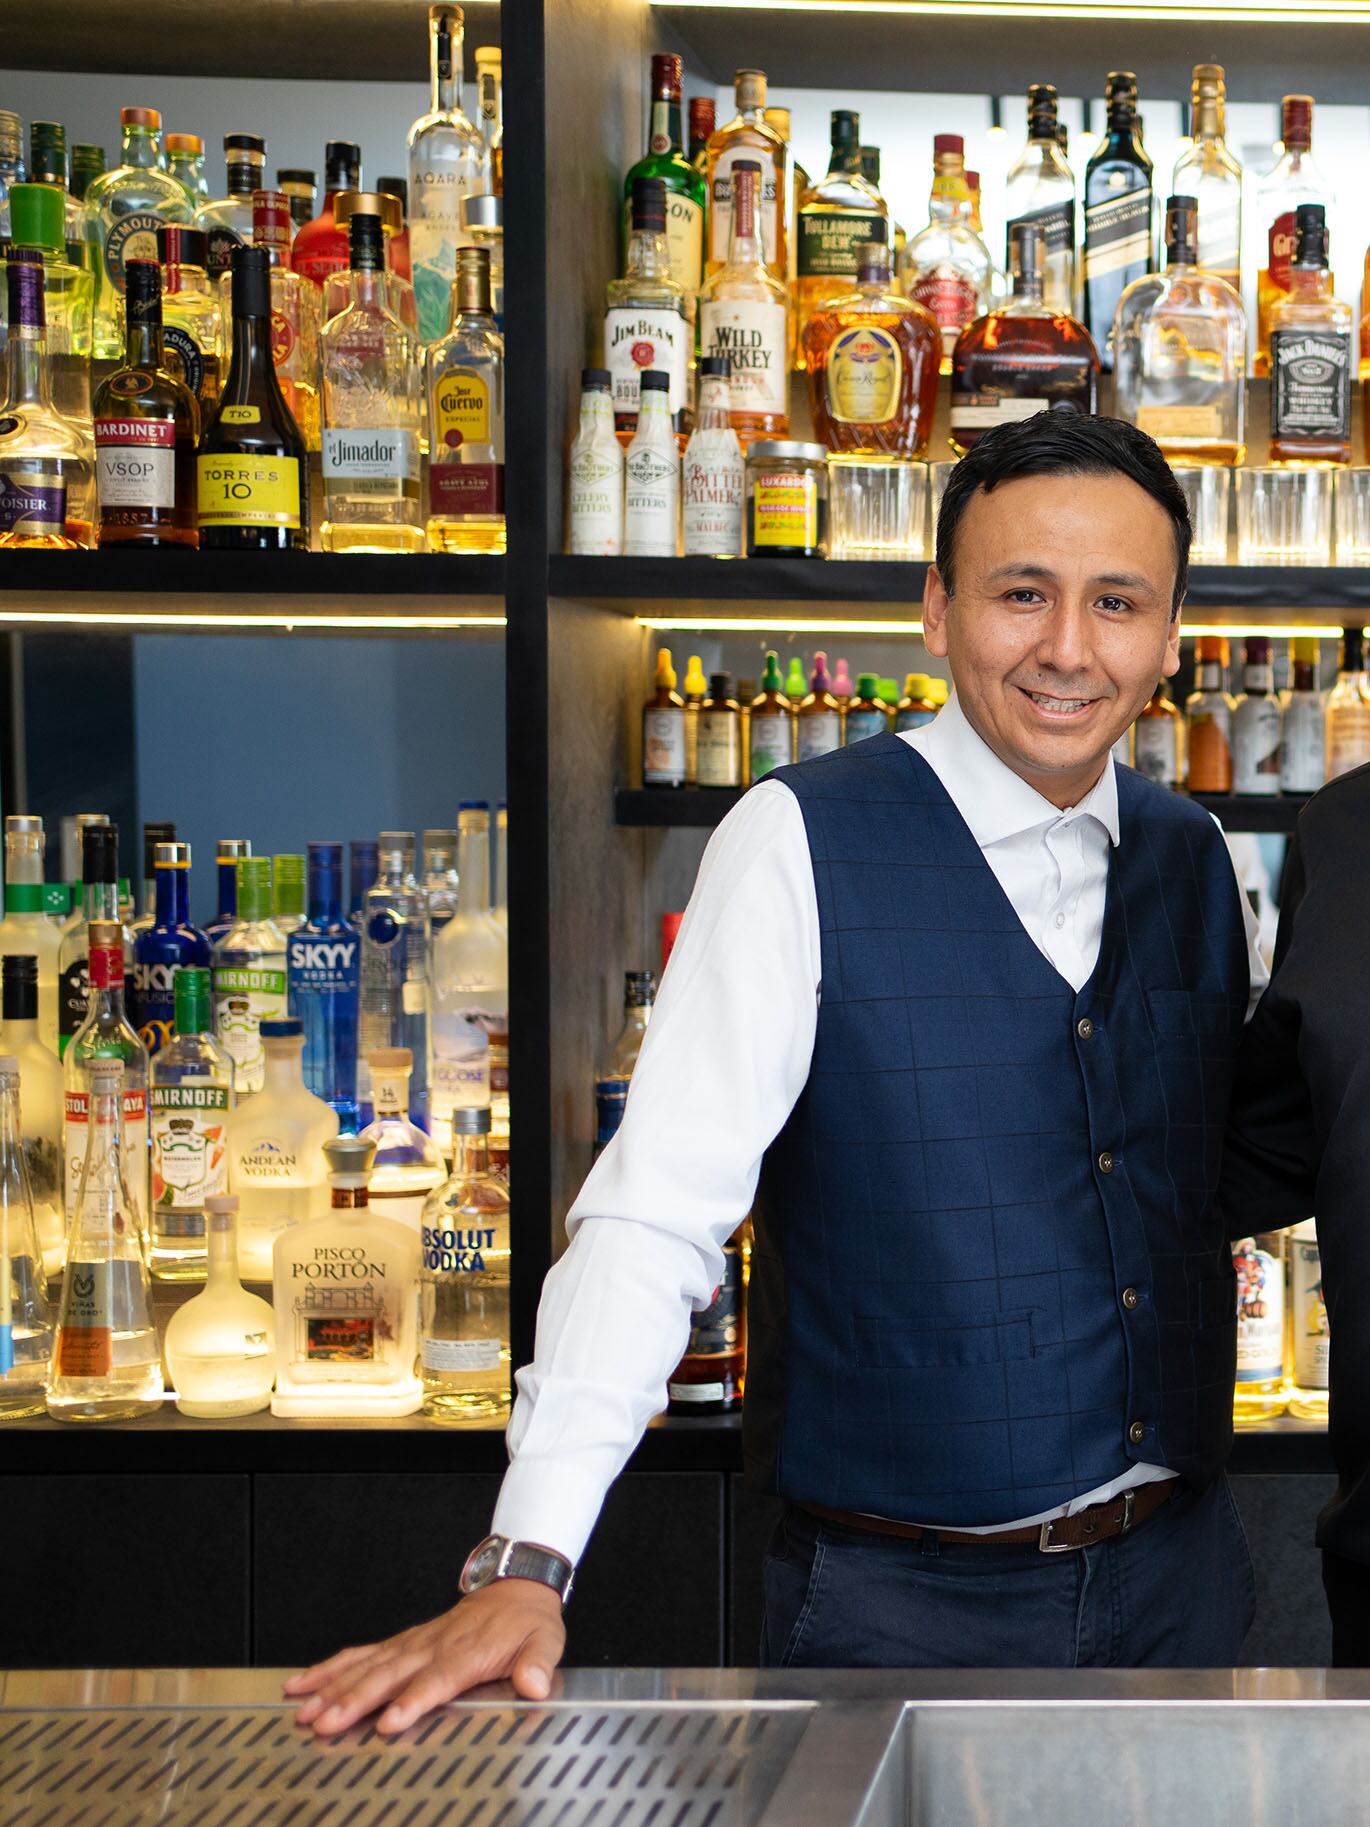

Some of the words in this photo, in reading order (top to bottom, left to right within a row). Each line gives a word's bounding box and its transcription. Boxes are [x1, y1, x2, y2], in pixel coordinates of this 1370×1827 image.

[414, 171, 467, 186] AQARA
[107, 212, 168, 260] PLYMOUT
[612, 324, 635, 346] JIM
[638, 320, 674, 347] BEAM
[714, 326, 762, 348] WILD
[440, 393, 484, 413] Cuervo
[97, 423, 167, 438] BARDINET
[332, 439, 396, 467] Jimador
[105, 462, 154, 476] VSOP
[205, 470, 279, 481] TORRES
[223, 483, 252, 499] 10
[0, 499, 47, 511] OISIER
[291, 943, 354, 969] SKYY
[303, 970, 344, 980] VODKA
[150, 1089, 224, 1109] SMIRNOFF
[240, 1155, 297, 1167] ANDEAN
[423, 1228, 497, 1250] BSOLUT
[314, 1247, 366, 1262] PISCO
